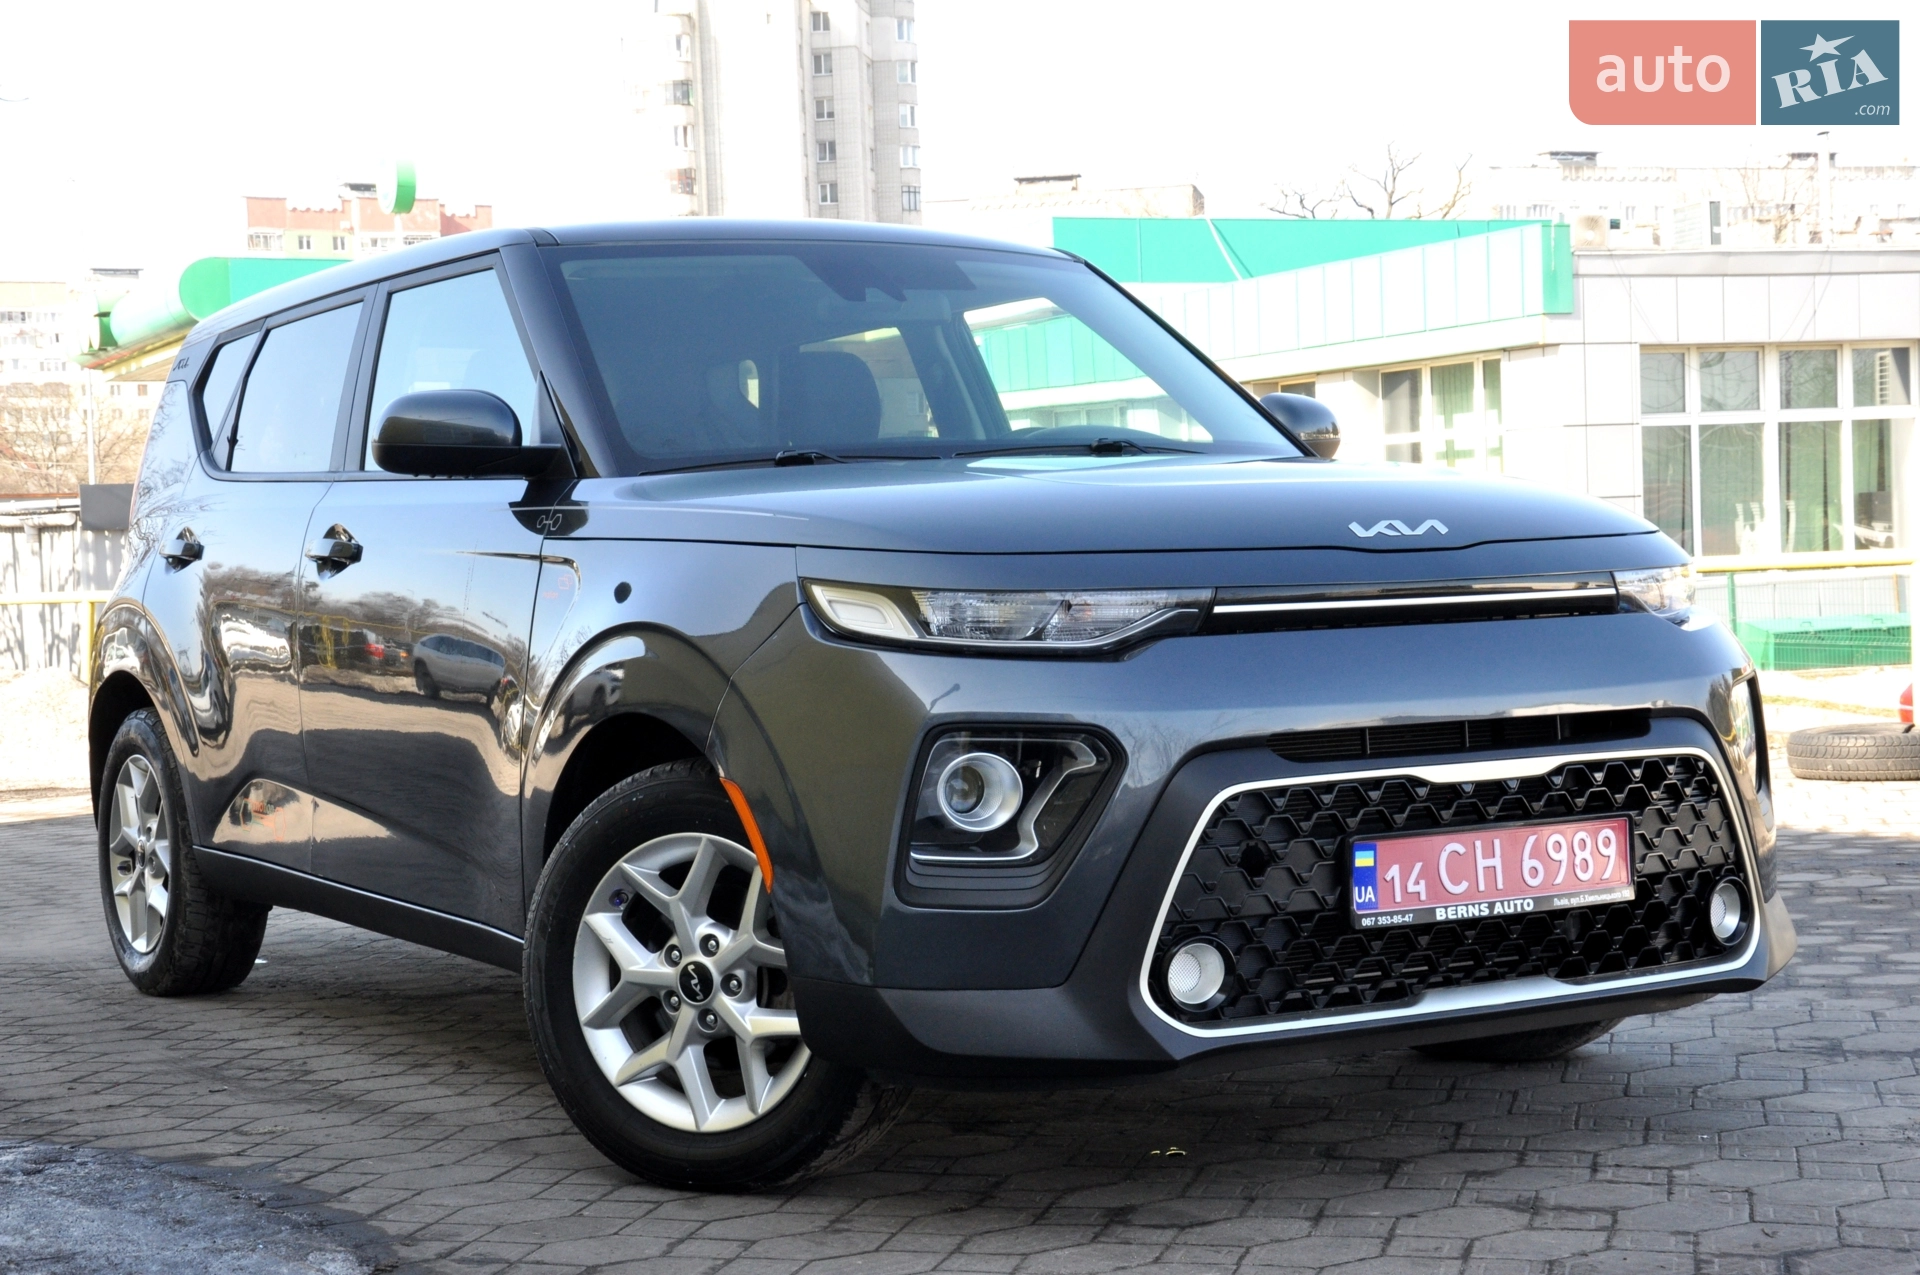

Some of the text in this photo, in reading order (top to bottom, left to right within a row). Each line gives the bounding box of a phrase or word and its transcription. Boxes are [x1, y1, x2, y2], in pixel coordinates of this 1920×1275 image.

[1347, 519, 1450, 538] KIA
[1383, 828, 1617, 903] 14 CH 6989
[1355, 886, 1376, 903] UA
[1435, 898, 1535, 920] BERNS AUTO
[1361, 914, 1414, 927] 067 353-85-47
